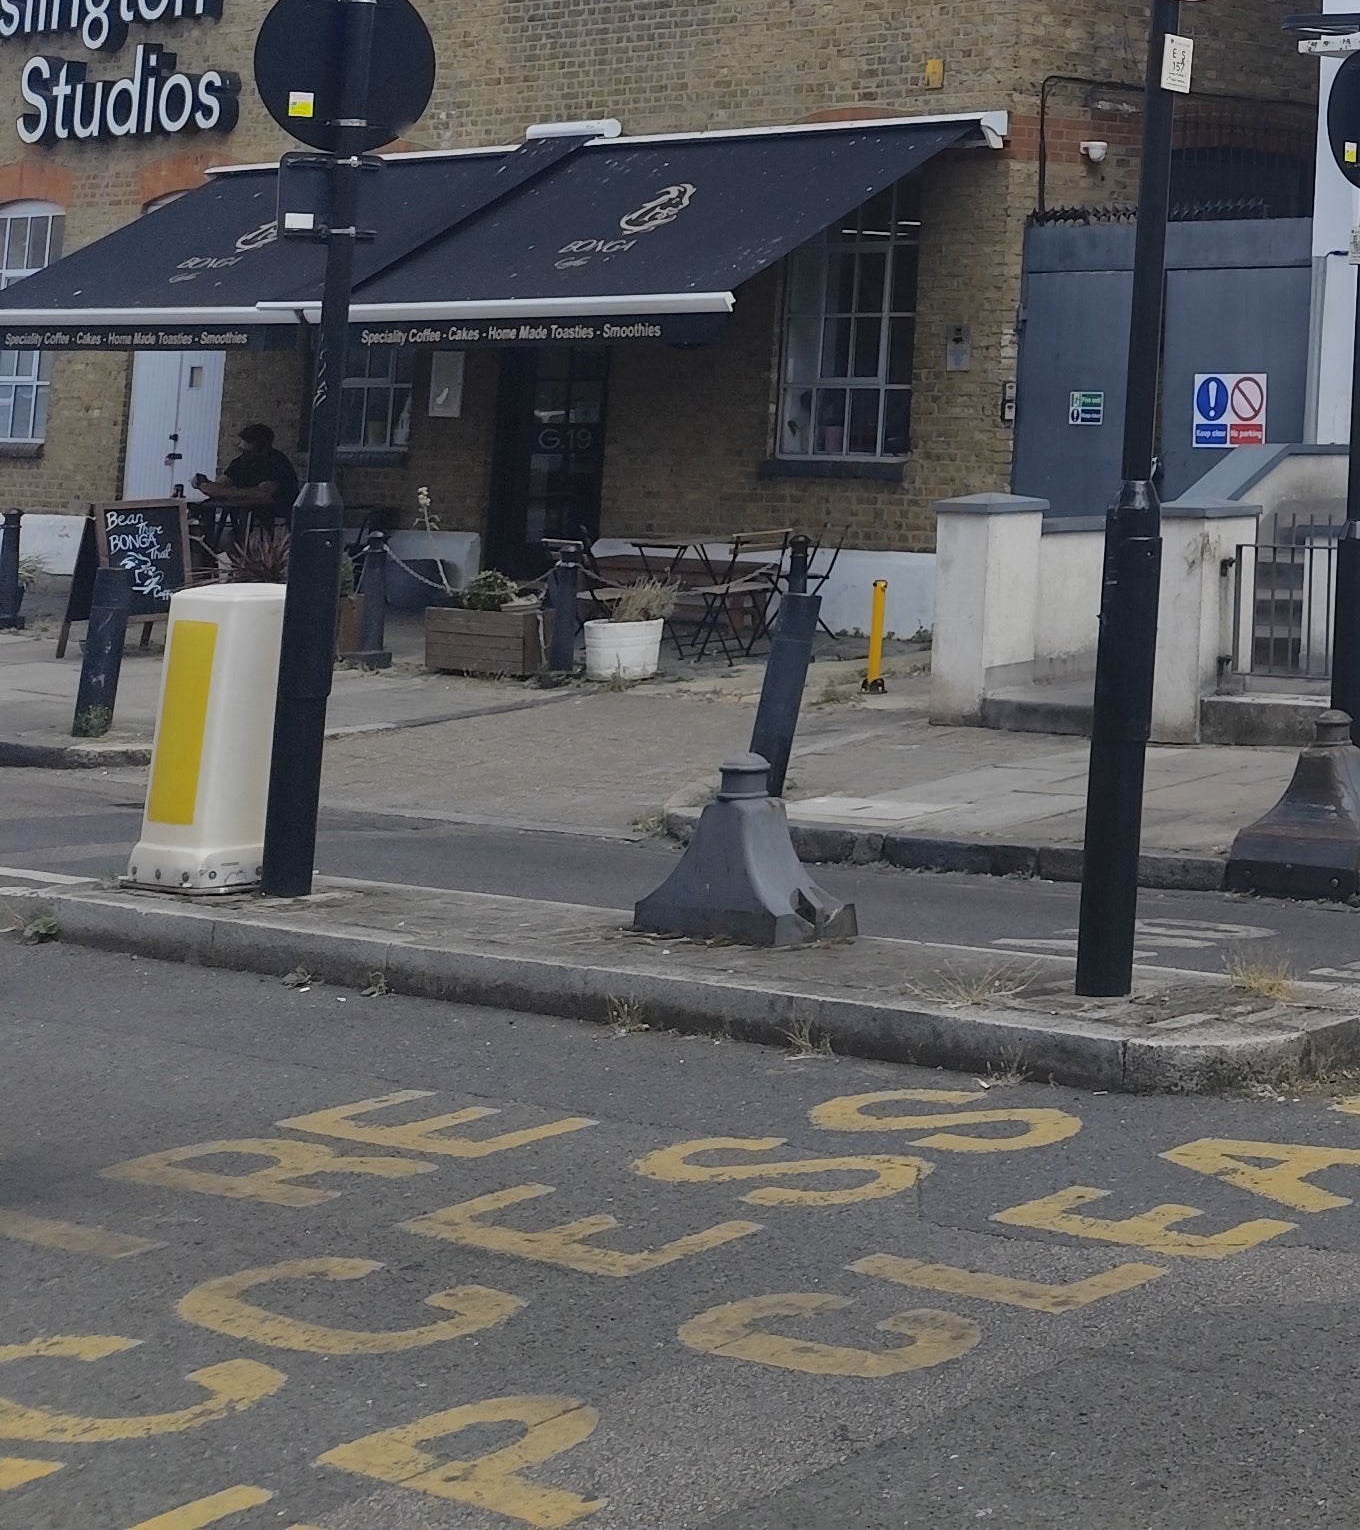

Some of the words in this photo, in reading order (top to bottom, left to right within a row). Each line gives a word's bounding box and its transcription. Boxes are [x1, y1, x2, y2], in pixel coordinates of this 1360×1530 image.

[16, 43, 223, 144] Studios
[5, 332, 43, 347] Speciality
[44, 332, 70, 345] Coffee
[76, 332, 102, 345] Cakes
[108, 332, 132, 345] Home
[133, 332, 156, 345] Made
[158, 332, 193, 345] Toasties
[200, 331, 248, 345] Smoothies
[361, 329, 407, 345] Speciality
[409, 328, 441, 343] Coffee
[448, 326, 480, 341] Cakes
[488, 326, 517, 340] Home
[519, 325, 548, 339] Made
[550, 324, 594, 339] Toasties
[602, 323, 661, 338] Smoothies
[1196, 429, 1212, 438] Keep
[1212, 429, 1226, 438] clear
[1230, 429, 1239, 437] No
[1239, 429, 1262, 439] parking
[109, 534, 157, 555] BONGA
[0, 1088, 1083, 1492] CCESS
